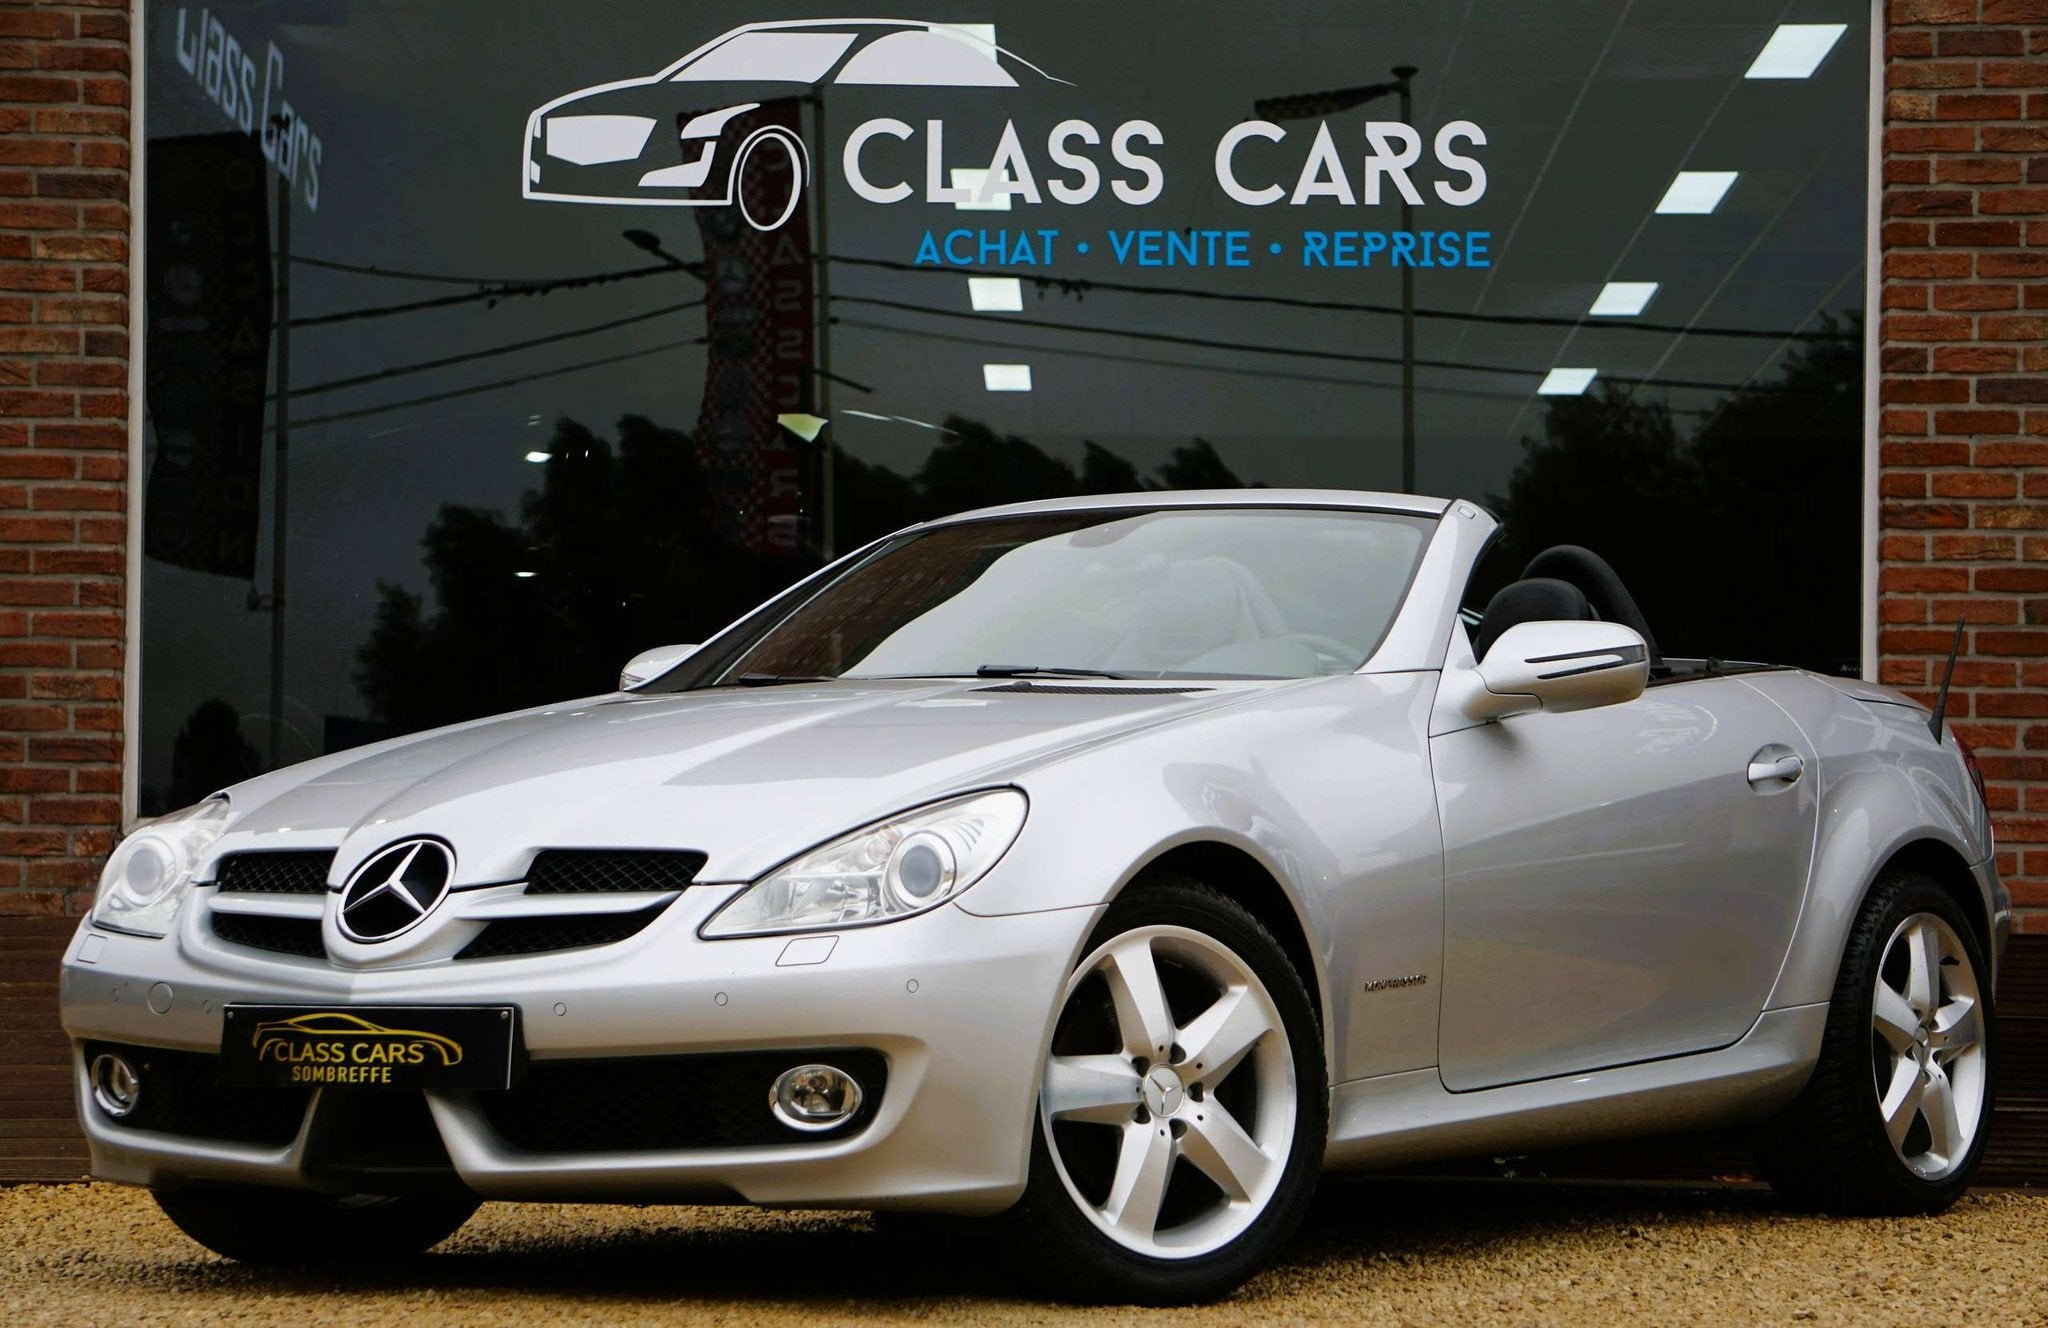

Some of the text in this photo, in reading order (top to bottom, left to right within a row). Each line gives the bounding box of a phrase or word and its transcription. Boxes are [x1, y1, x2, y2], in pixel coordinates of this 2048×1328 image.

[260, 40, 323, 212] Cars
[844, 119, 1488, 207] CLASS CARS
[914, 229, 1491, 268] ACHAT VENTE REPRISE
[274, 1041, 425, 1064] CLASS CARS
[292, 1065, 392, 1084] SOMBREFFE
